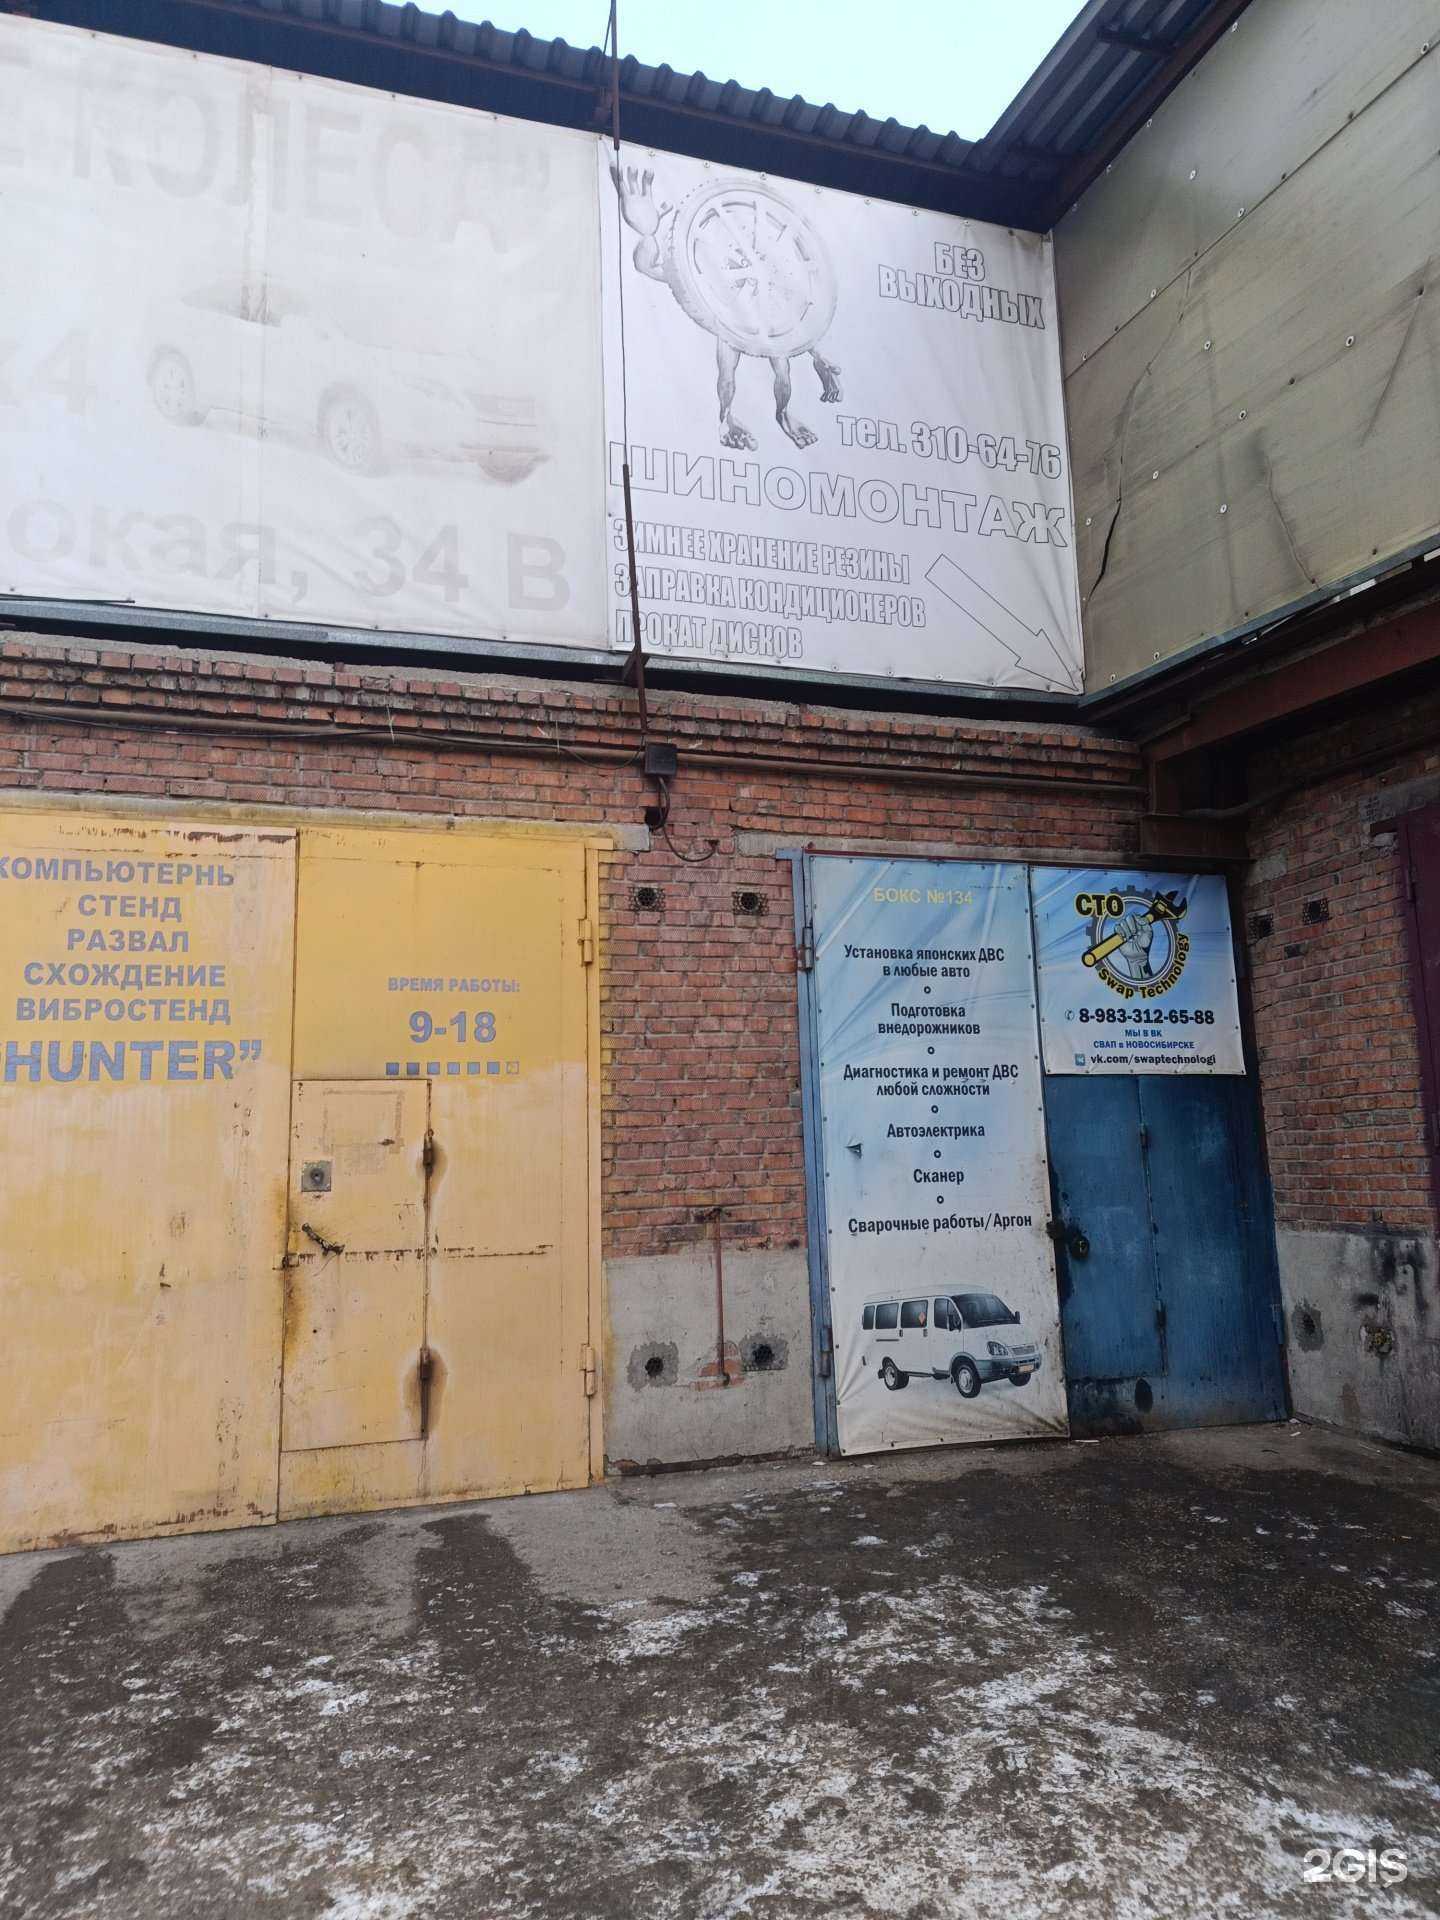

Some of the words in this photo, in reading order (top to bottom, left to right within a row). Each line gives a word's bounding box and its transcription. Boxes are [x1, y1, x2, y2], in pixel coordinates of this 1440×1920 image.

[934, 241, 986, 282] БЕЗ
[878, 263, 1046, 330] ВЫХОДНЫХ
[836, 414, 908, 454] тел.
[910, 420, 1062, 480] 310-64-76
[609, 440, 1068, 548] ШИНОМОНТАЖ
[612, 517, 706, 561] ЗИМНЕЕ
[708, 530, 818, 575] ХРАНЕНИЕ
[822, 544, 911, 585] РЕЗИНЫ
[352, 515, 470, 603] 34
[505, 530, 572, 612] В
[613, 562, 736, 608] ЗАПРАВКА
[738, 576, 928, 628] КОНДИЦИОНЕРОВ
[615, 608, 707, 649] ПРОКАТ
[709, 618, 803, 659] ДИСКОВ
[873, 887, 922, 903] БОКС
[926, 888, 974, 905] №134
[1074, 892, 1126, 918] СТО
[78, 894, 182, 923] СТЕНД
[67, 928, 190, 953] РАЗВАЛ
[844, 944, 914, 960] Установка
[916, 949, 977, 962] японских
[978, 948, 1005, 964] ДВС
[1098, 968, 1135, 999] Swap
[1139, 932, 1190, 999] Technology
[24, 962, 226, 991] СХОЖДЕНИЕ
[883, 965, 891, 976] в
[893, 962, 938, 977] любые
[941, 966, 970, 978] авто
[388, 976, 444, 992] ВРЕМЯ
[448, 978, 521, 993] РАБОТЫ:
[16, 997, 231, 1026] ВИБРОСТЕНД
[891, 1002, 966, 1018] Подготовка
[1079, 1007, 1215, 1025] 8-983-312-65-88
[409, 1010, 497, 1043] 9-18
[878, 1021, 981, 1037] внедорожников
[1125, 1028, 1141, 1038] МЫ
[1151, 1028, 1163, 1038] ВК
[1093, 1040, 1117, 1049] СВАП
[1126, 1040, 1195, 1049] НОВОСИБИРСКЕ
[1090, 1053, 1216, 1066] vk.com/swaptechnologi
[843, 1064, 929, 1080] Диагностика
[931, 1067, 940, 1078] и
[943, 1066, 990, 1081] ремонт
[992, 1064, 1018, 1080] ДВС
[876, 1080, 919, 1096] любой
[921, 1083, 990, 1097] сложности
[887, 1123, 985, 1140] Автоэлектрика
[913, 1168, 965, 1185] Сканер
[848, 1216, 930, 1235] Сварочные
[933, 1212, 1032, 1232] работы/Аргон
